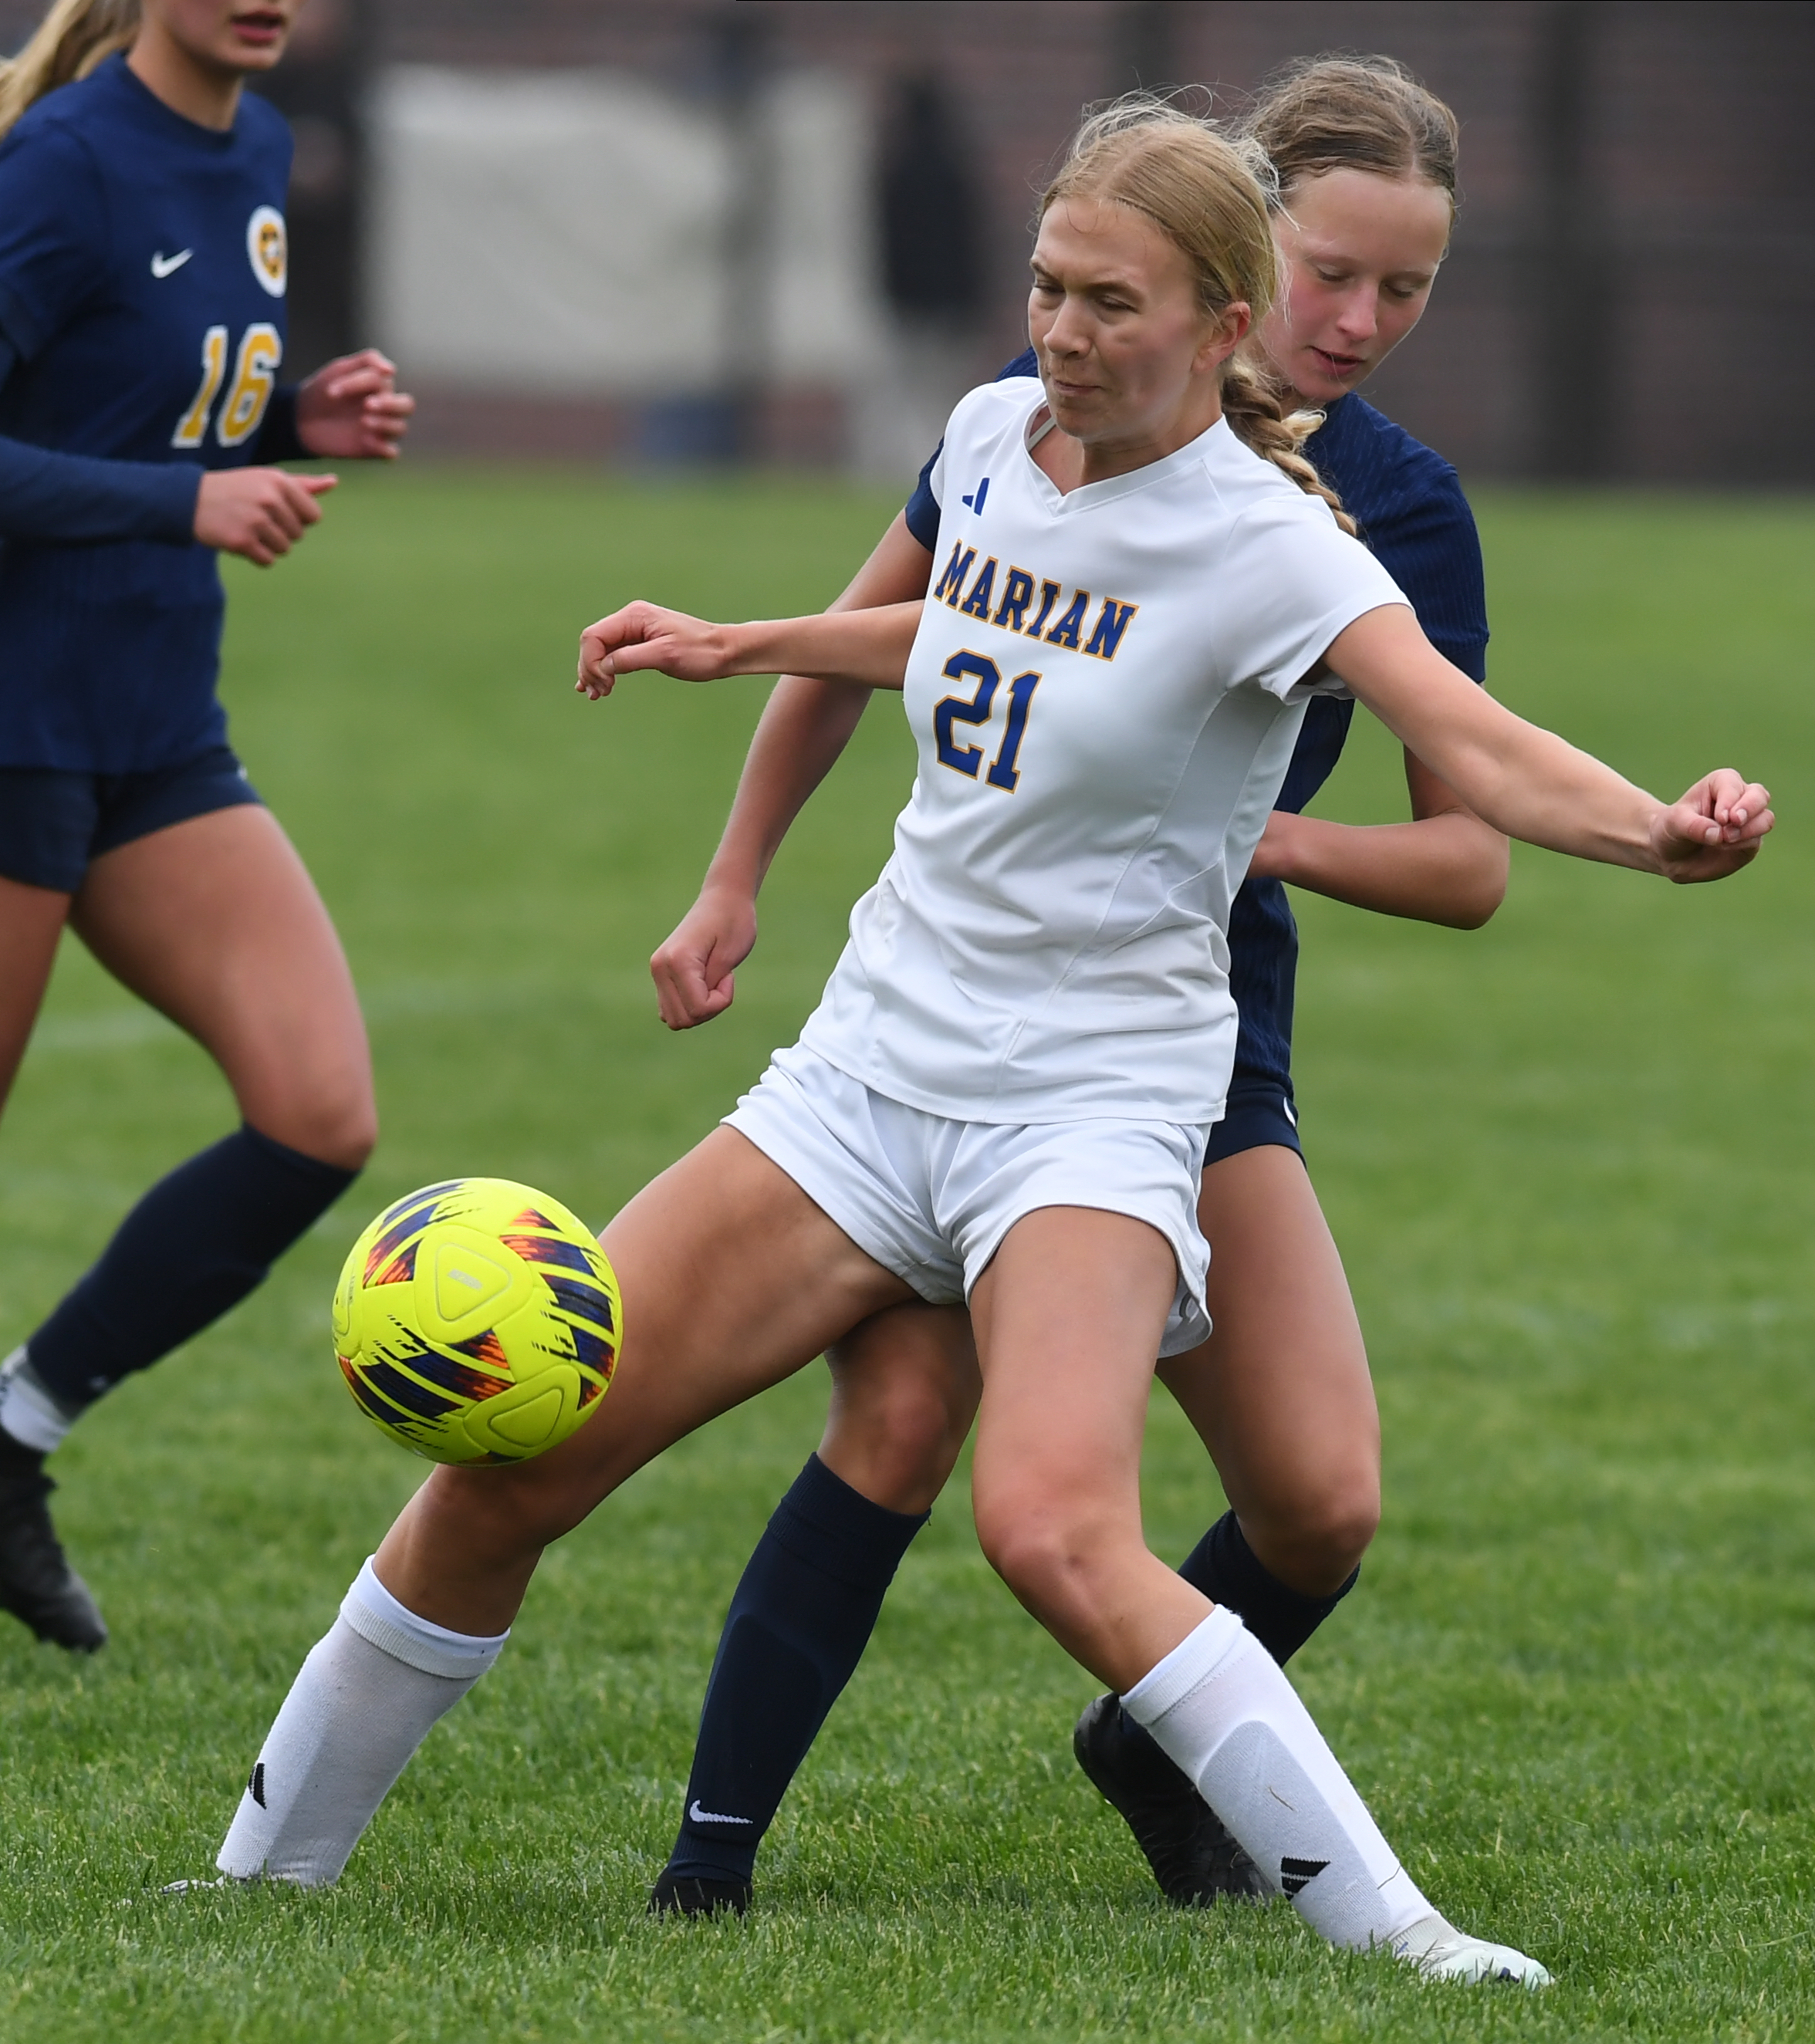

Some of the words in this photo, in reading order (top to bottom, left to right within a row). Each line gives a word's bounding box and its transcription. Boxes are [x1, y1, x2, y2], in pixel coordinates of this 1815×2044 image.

[171, 322, 282, 448] 16
[933, 539, 1139, 662] MARIAN
[933, 648, 1043, 794] 21
